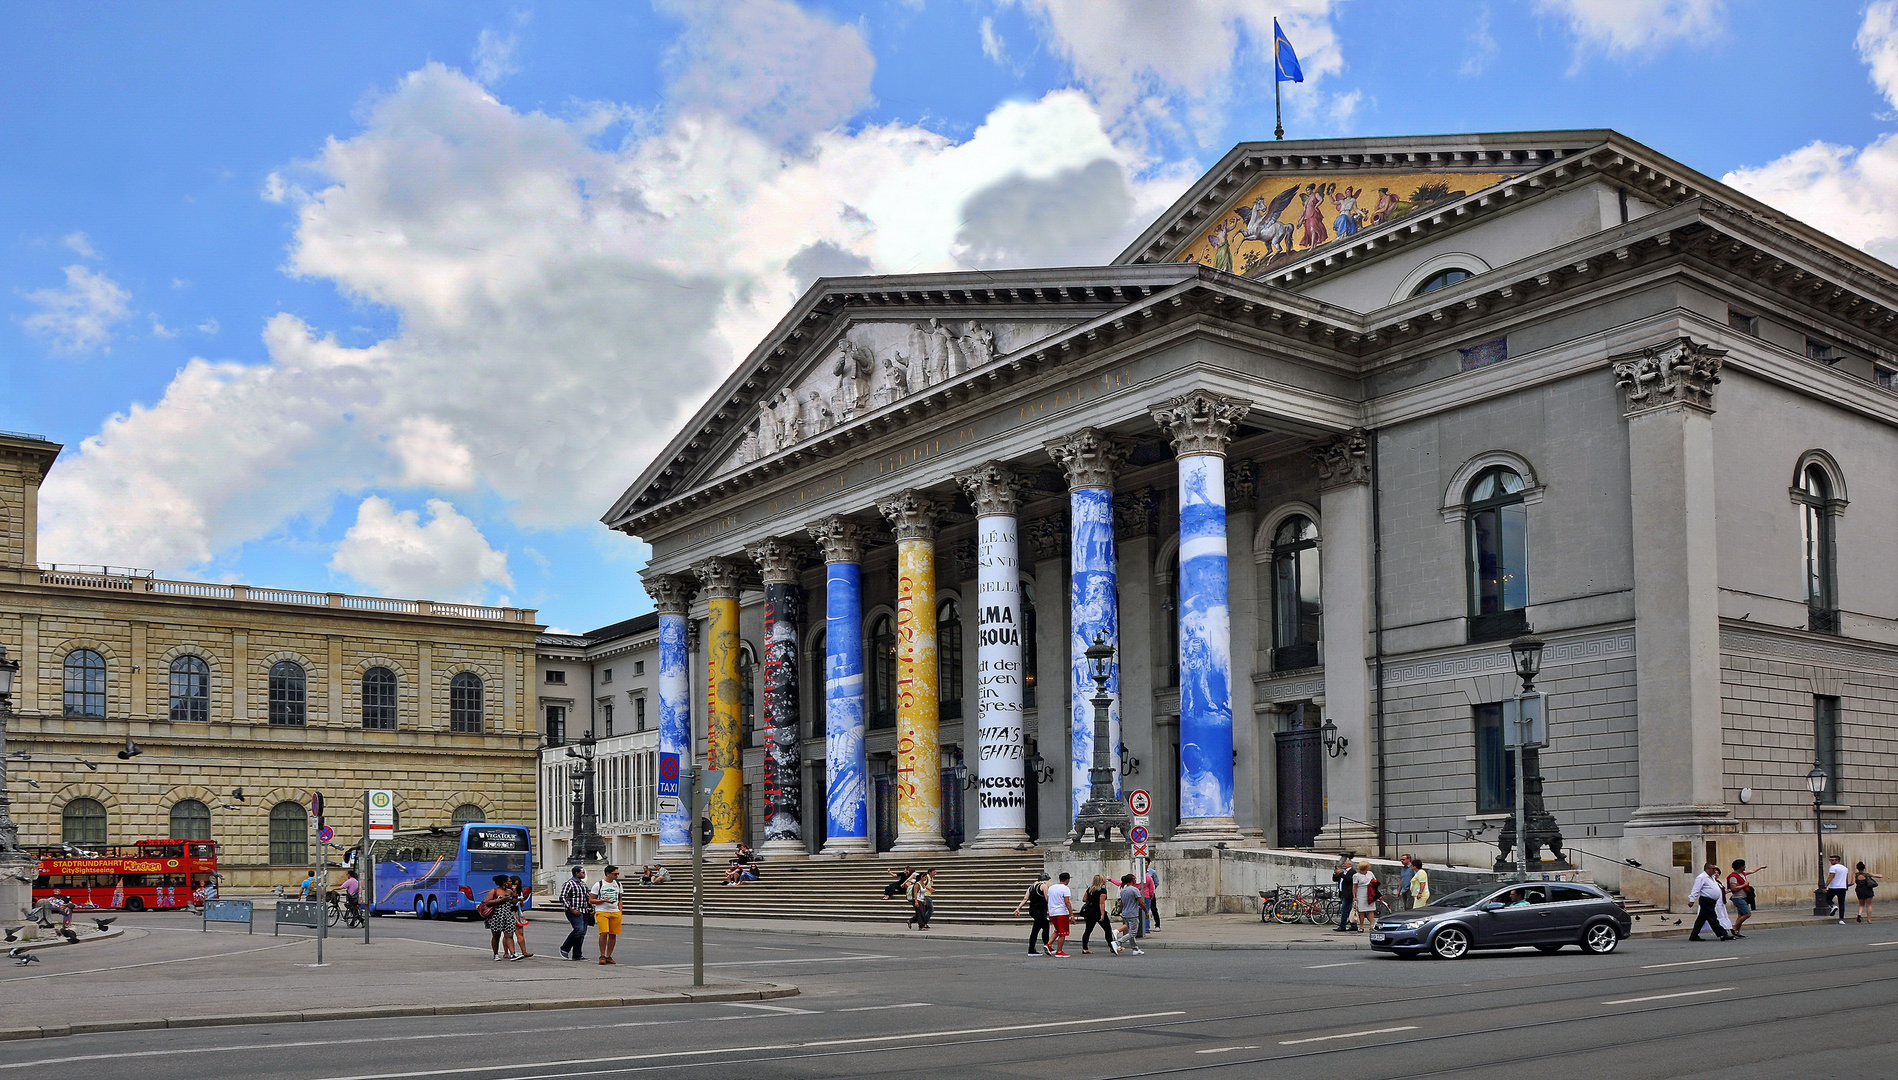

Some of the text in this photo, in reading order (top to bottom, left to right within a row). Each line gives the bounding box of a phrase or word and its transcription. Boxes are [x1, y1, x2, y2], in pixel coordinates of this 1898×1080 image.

[979, 530, 1016, 545] LÉAS
[978, 606, 1013, 625] LMA
[994, 659, 1021, 671] der
[978, 726, 1020, 742] HTA'S
[660, 782, 678, 793] TAXI
[53, 860, 123, 868] STADTRUNDFAHRT
[124, 861, 162, 872] München
